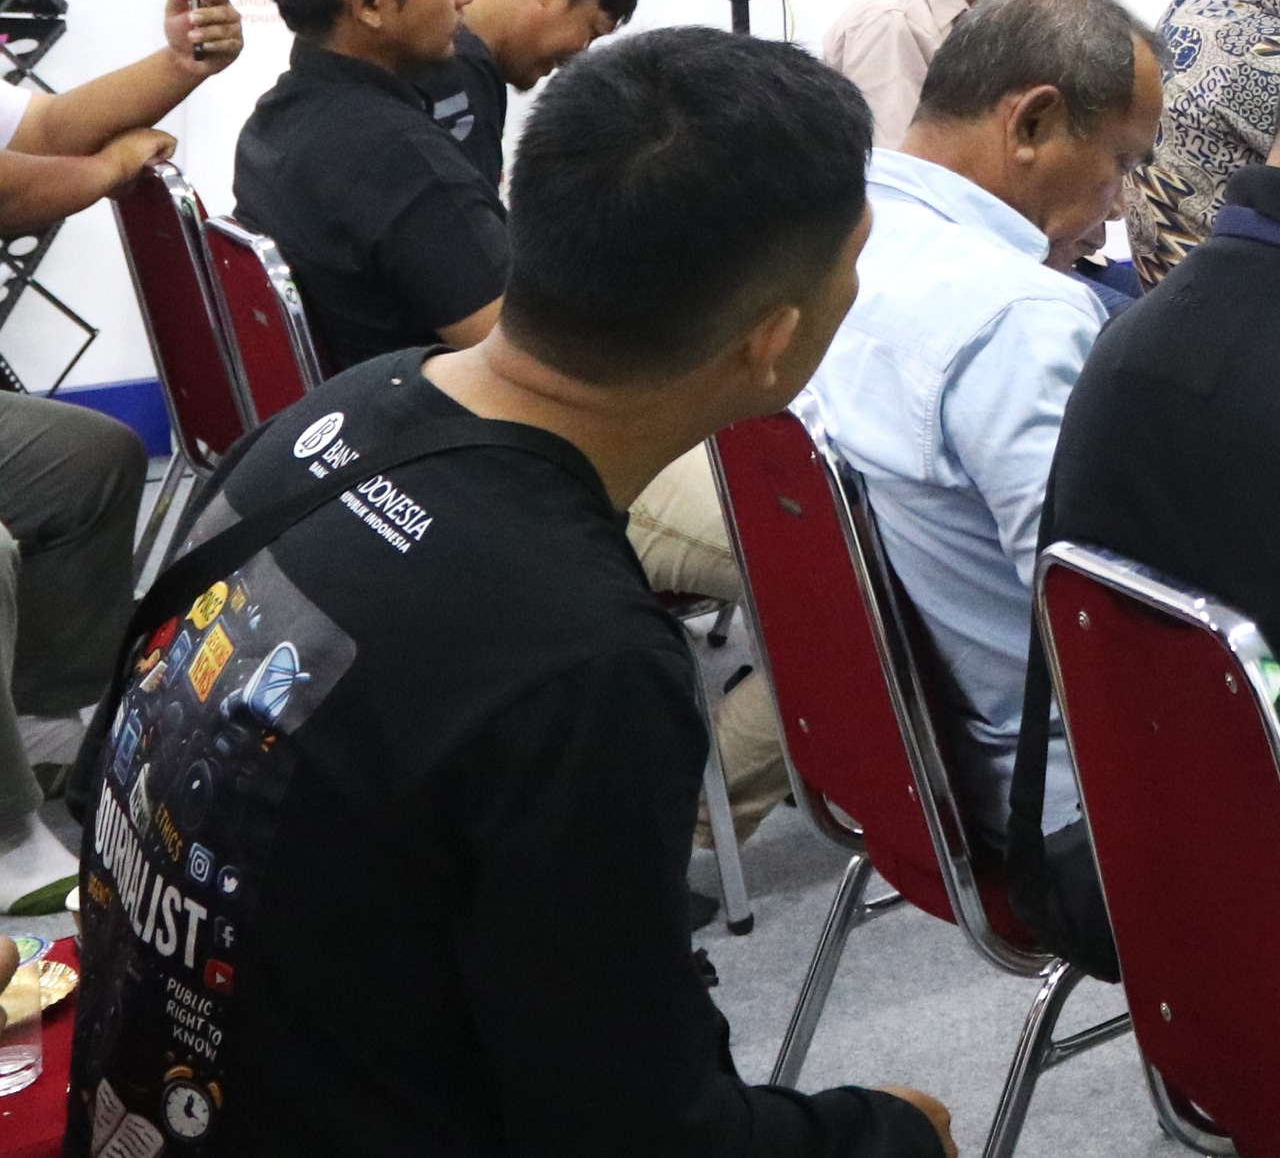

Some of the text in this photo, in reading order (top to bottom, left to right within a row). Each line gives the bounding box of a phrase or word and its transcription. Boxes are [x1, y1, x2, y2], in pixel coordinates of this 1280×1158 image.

[356, 474, 434, 541] DONESIA
[364, 512, 411, 553] INDONESIA
[191, 647, 217, 696] NEWS
[155, 802, 184, 863] ETHICS
[95, 778, 208, 969] JOURNALIST
[166, 977, 213, 1016] PUBLIC
[166, 999, 222, 1046] RIGHT TO
[173, 1026, 217, 1062] KNOW
